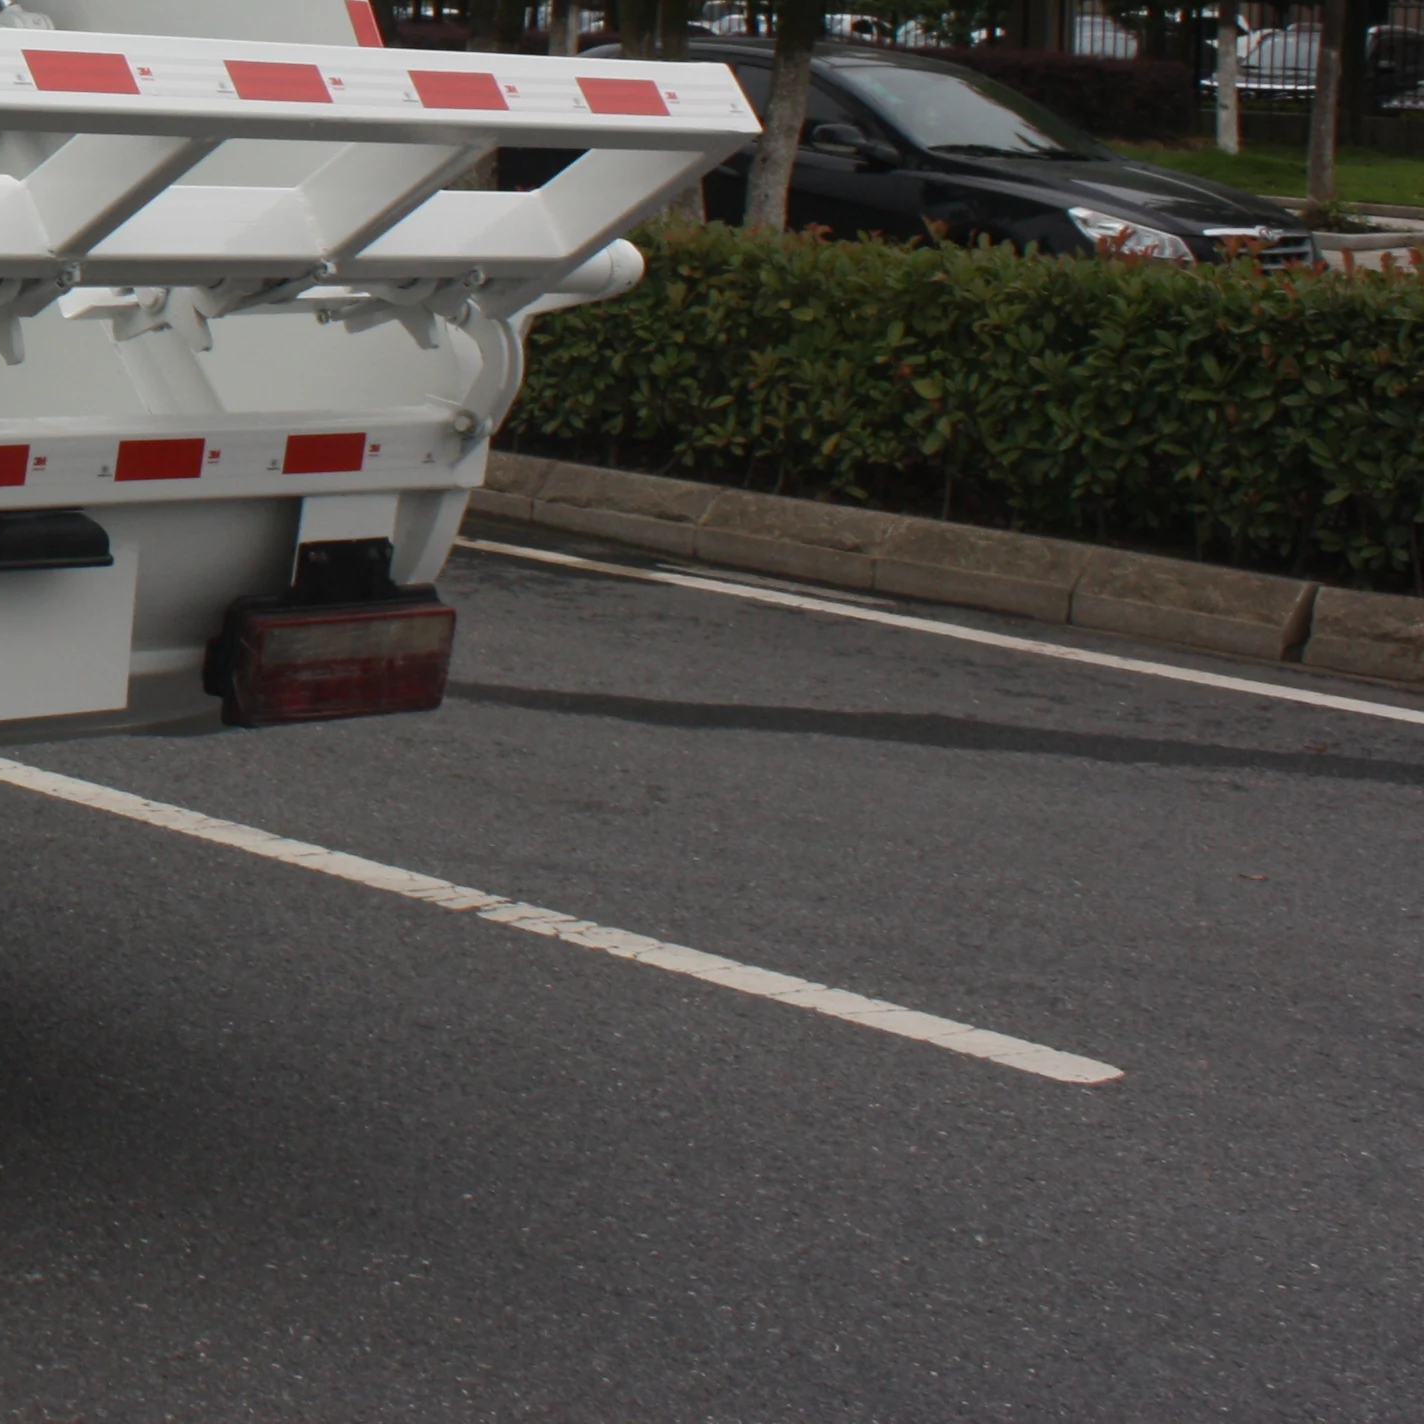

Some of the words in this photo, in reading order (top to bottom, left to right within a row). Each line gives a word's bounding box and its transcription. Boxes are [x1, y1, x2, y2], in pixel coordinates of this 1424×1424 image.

[136, 67, 153, 77] 3M
[208, 450, 221, 459] 3M
[33, 455, 47, 465] 3M
